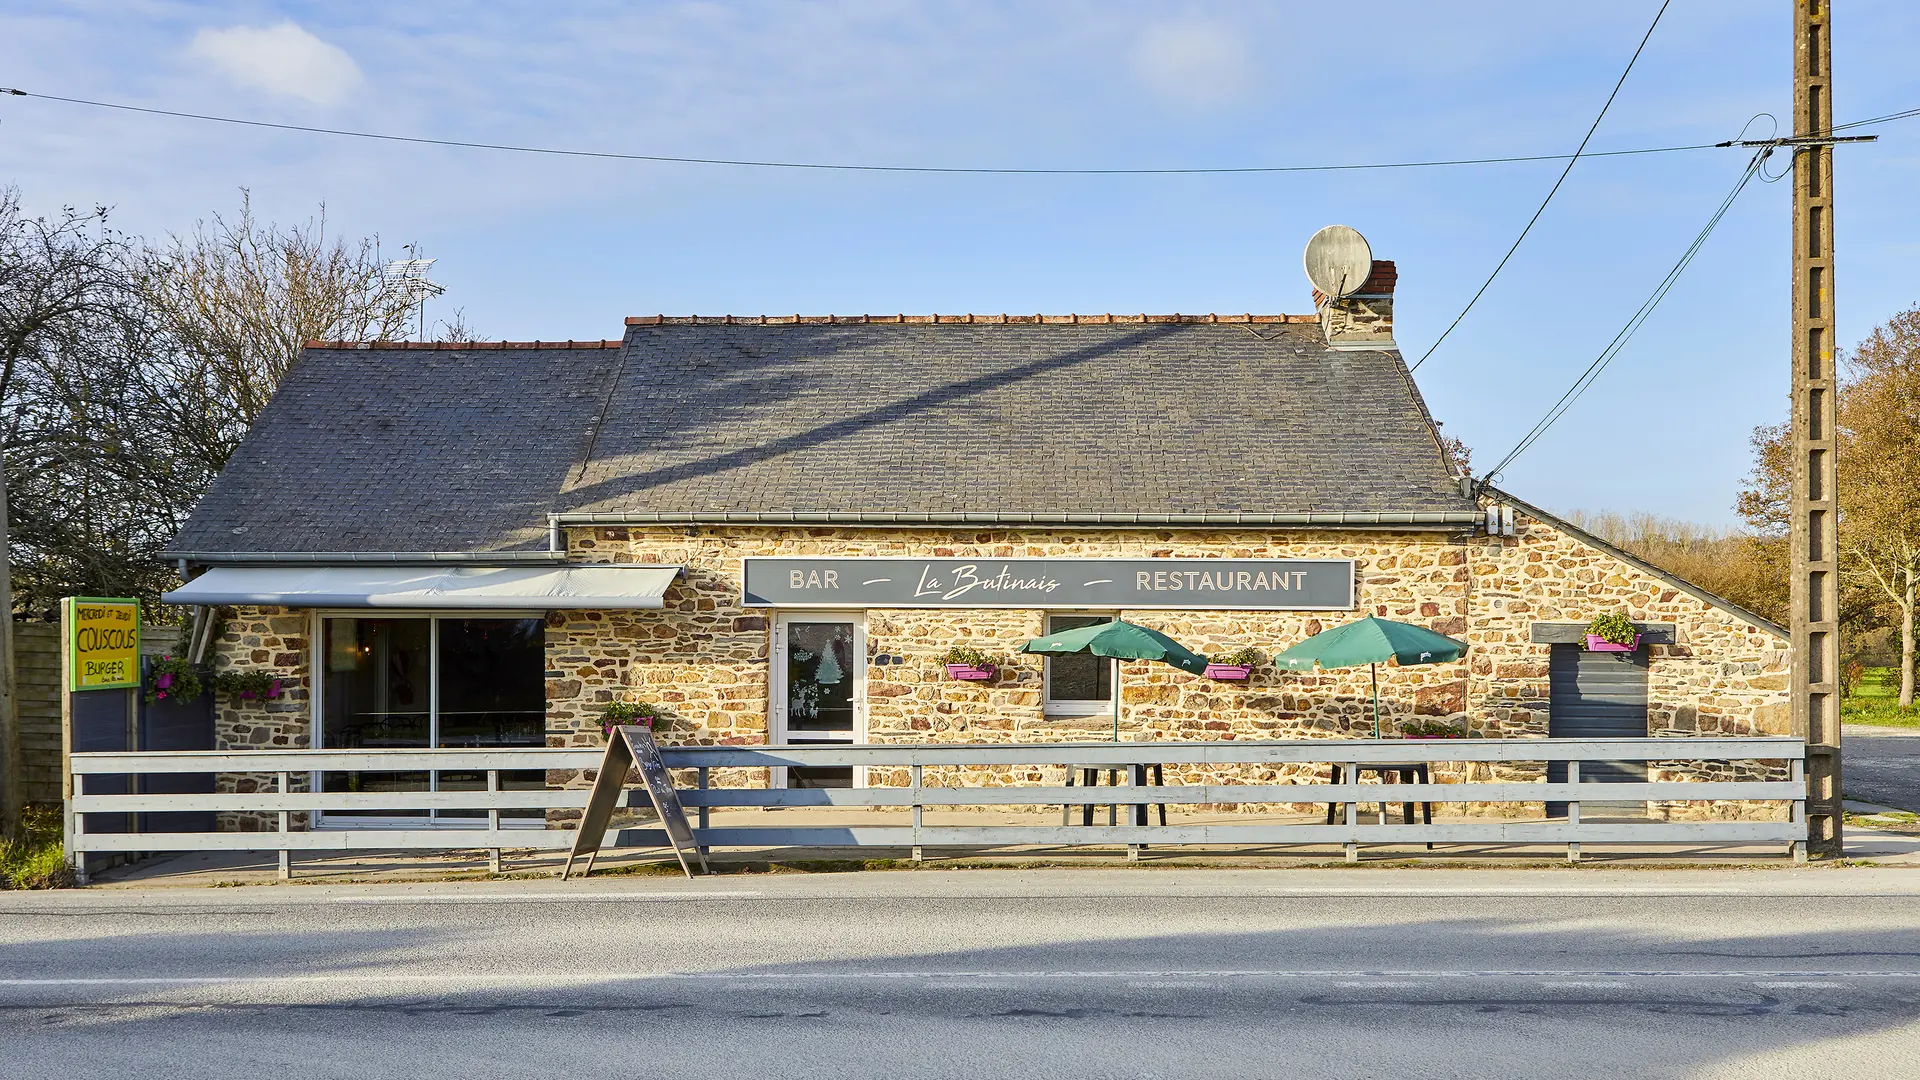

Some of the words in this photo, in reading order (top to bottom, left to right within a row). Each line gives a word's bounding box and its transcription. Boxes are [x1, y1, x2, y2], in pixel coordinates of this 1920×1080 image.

[790, 570, 839, 589] BAR
[914, 564, 942, 598] La
[942, 564, 1060, 600] Butinais
[1136, 570, 1308, 591] RESTAURANT
[77, 627, 136, 652] COUSCOUS
[85, 661, 125, 676] BURGER
